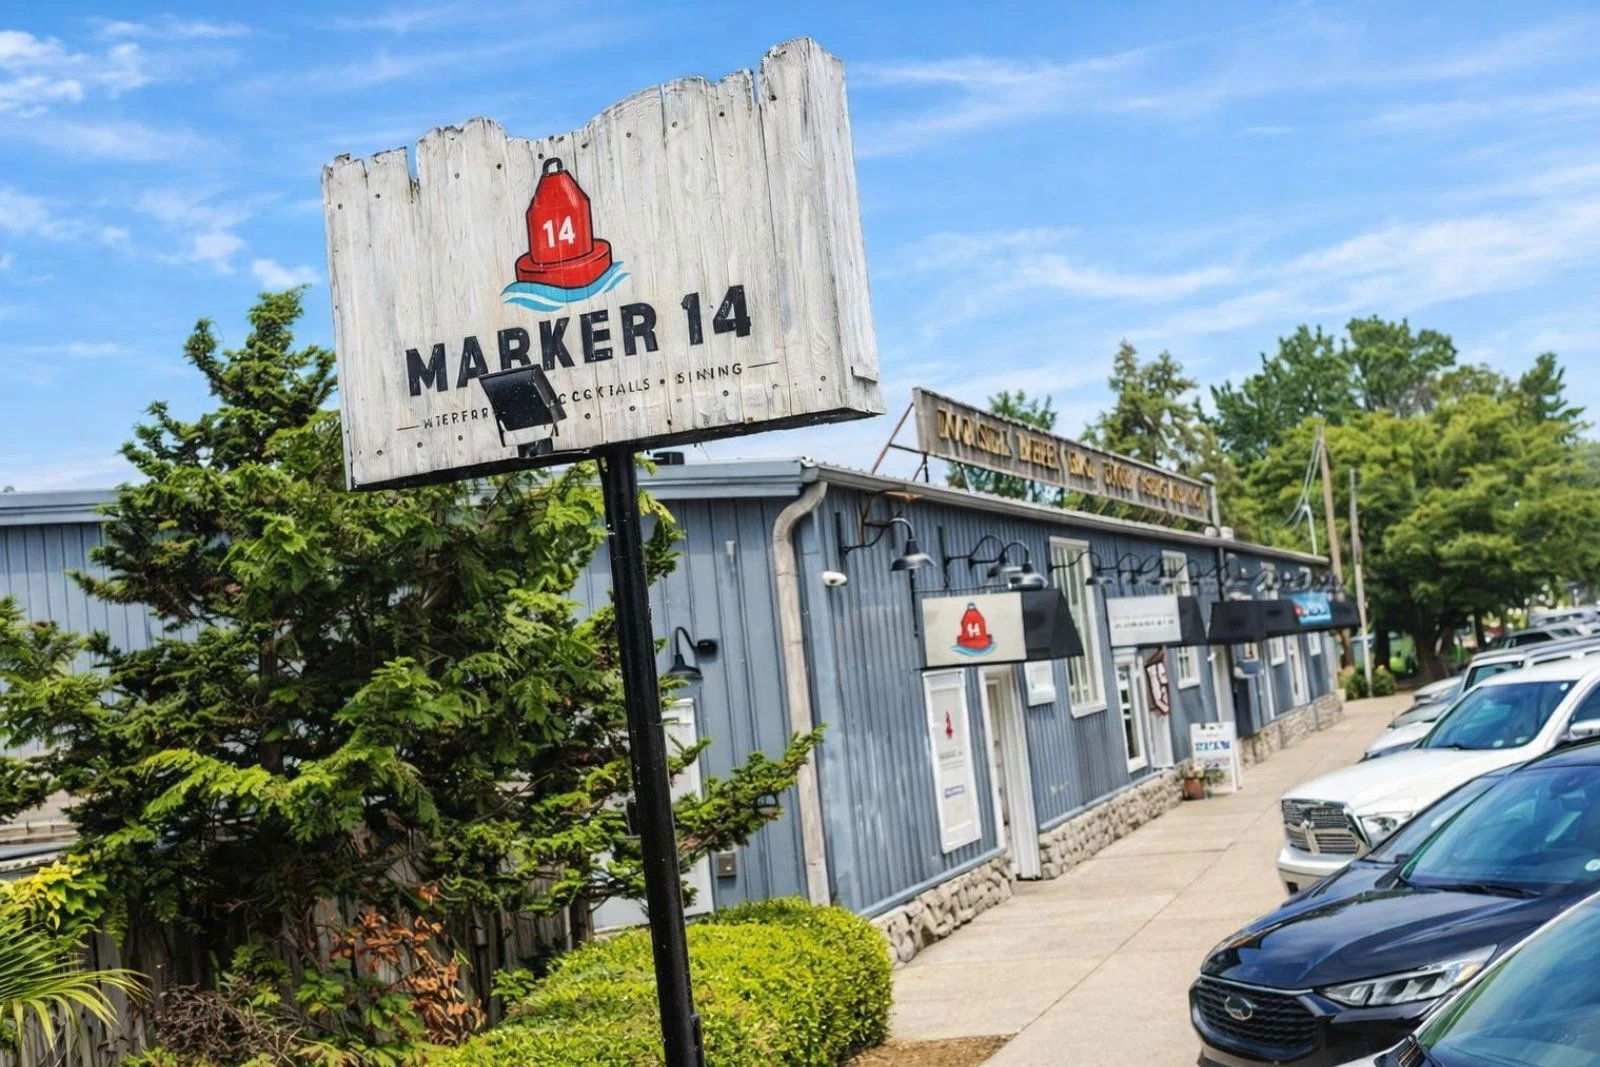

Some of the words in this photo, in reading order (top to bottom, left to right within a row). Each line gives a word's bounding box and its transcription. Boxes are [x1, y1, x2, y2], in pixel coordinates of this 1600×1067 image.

[542, 215, 576, 249] 14
[405, 301, 660, 397] MARKER
[680, 284, 752, 346] 14
